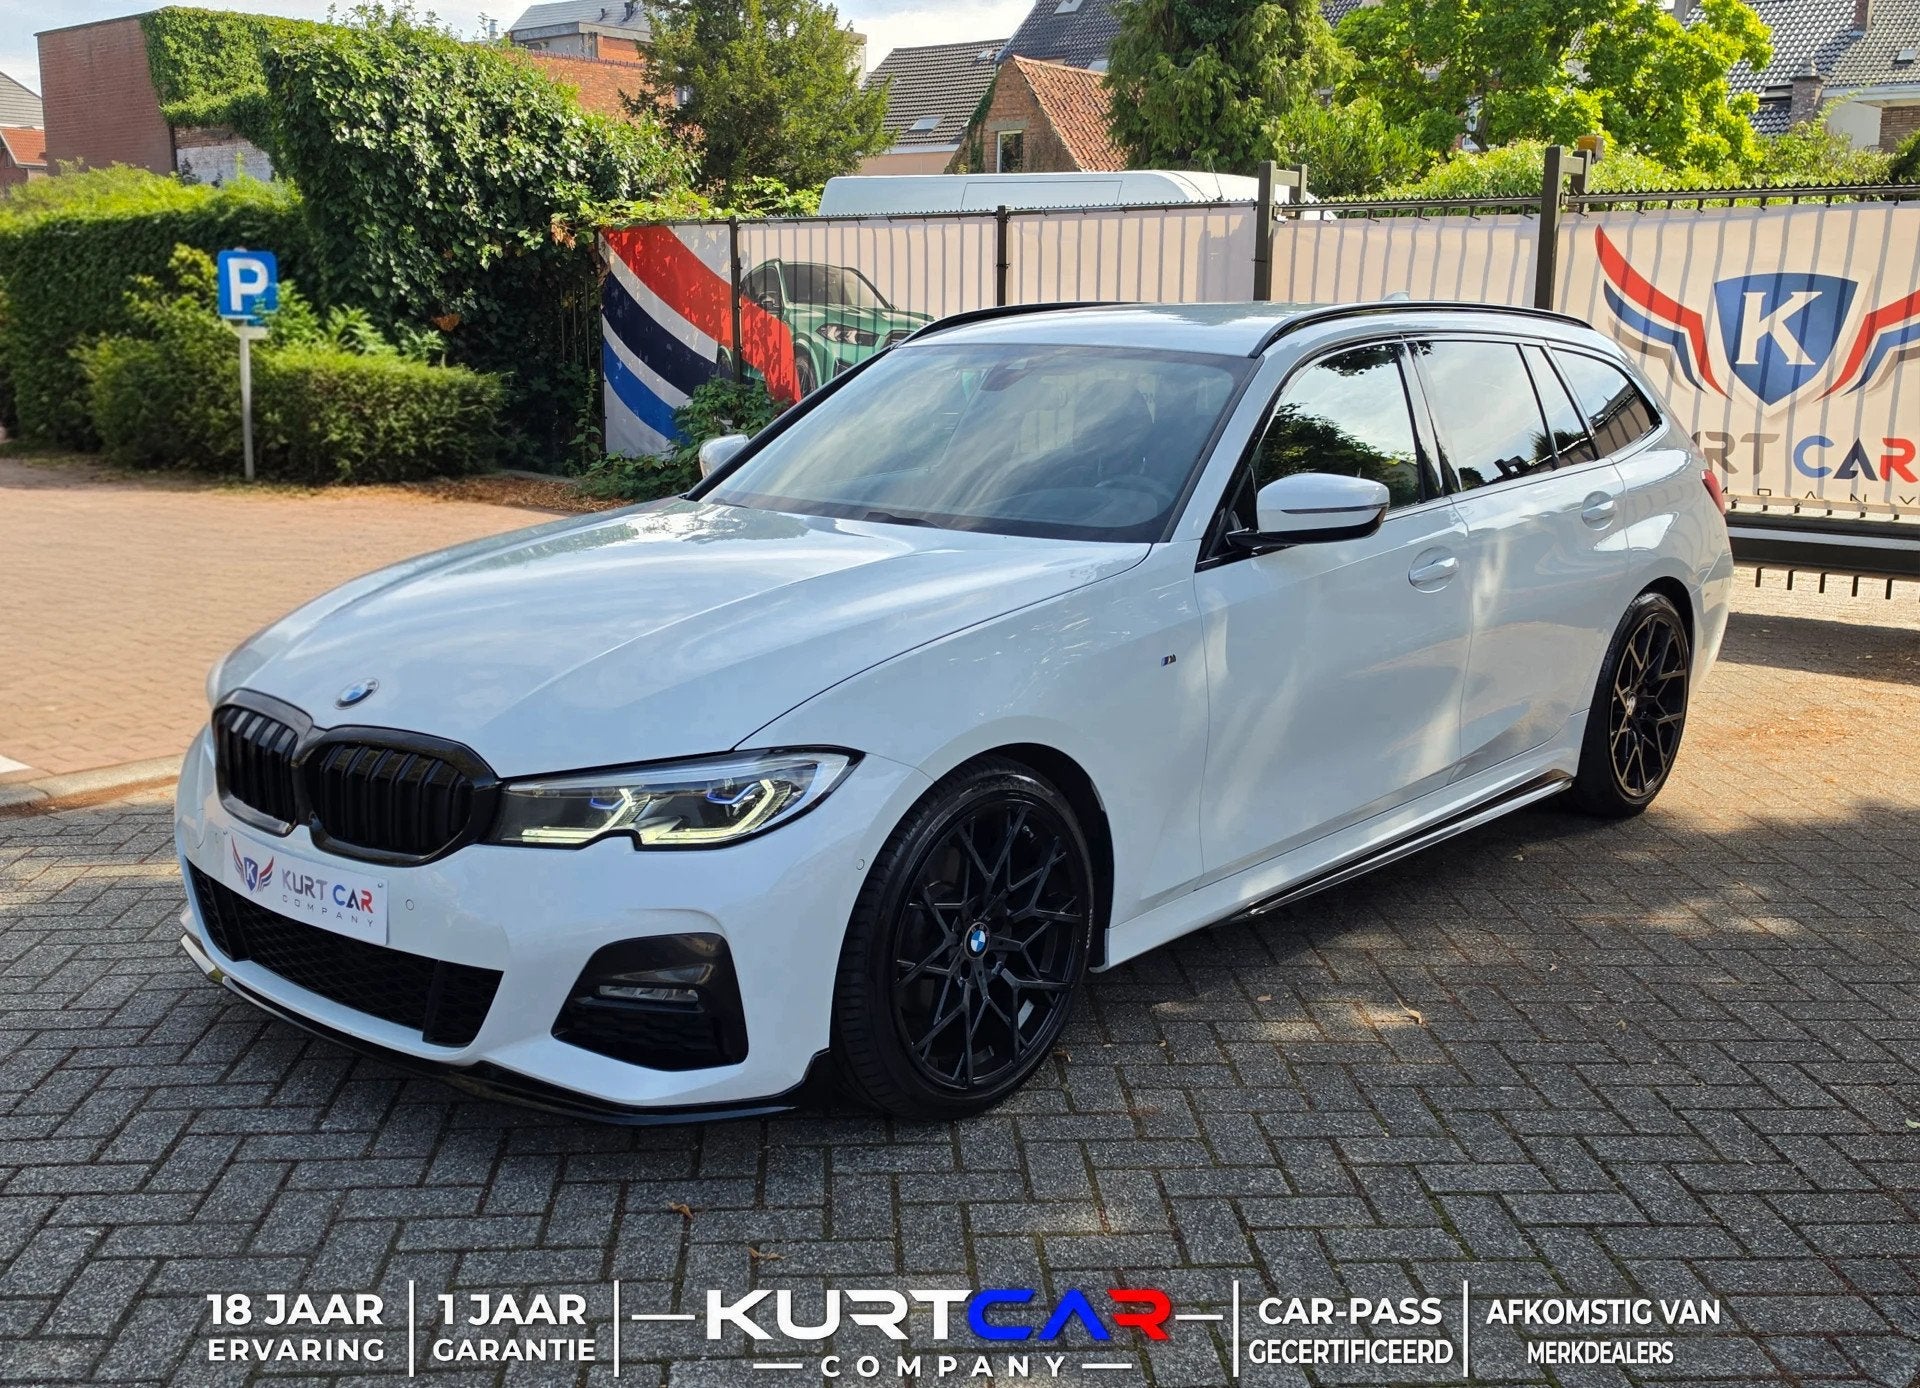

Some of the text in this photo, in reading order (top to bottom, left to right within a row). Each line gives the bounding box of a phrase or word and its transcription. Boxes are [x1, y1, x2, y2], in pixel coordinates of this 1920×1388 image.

[227, 258, 268, 311] P
[1735, 291, 1822, 365] K
[1691, 431, 1919, 483] RT CAR
[246, 862, 255, 885] K
[282, 868, 373, 914] KURT CAR
[282, 894, 377, 927] COMPANY
